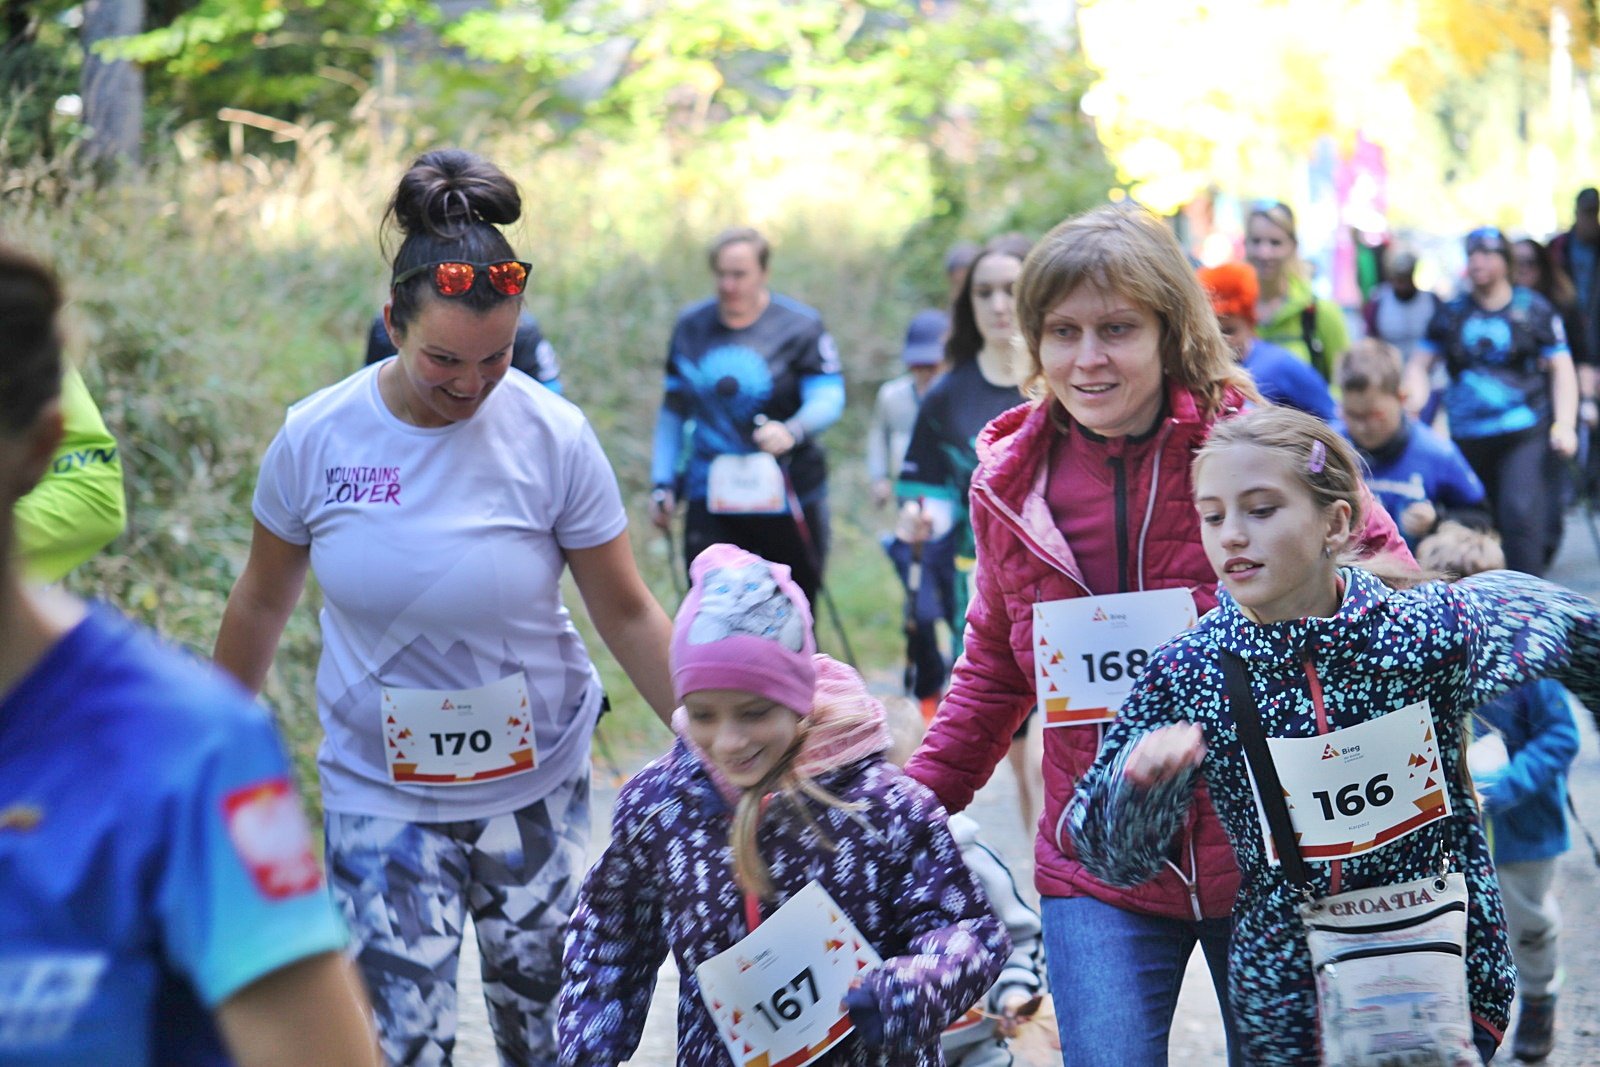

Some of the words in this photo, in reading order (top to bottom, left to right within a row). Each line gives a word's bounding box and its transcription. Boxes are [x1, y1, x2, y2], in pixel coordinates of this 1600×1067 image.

[324, 483, 401, 506] LOVER
[1081, 648, 1149, 683] 168
[429, 729, 492, 756] 170
[1341, 744, 1361, 756] Bieg
[1312, 773, 1394, 821] 166
[1328, 887, 1435, 917] CROATIA
[752, 965, 821, 1033] 167
